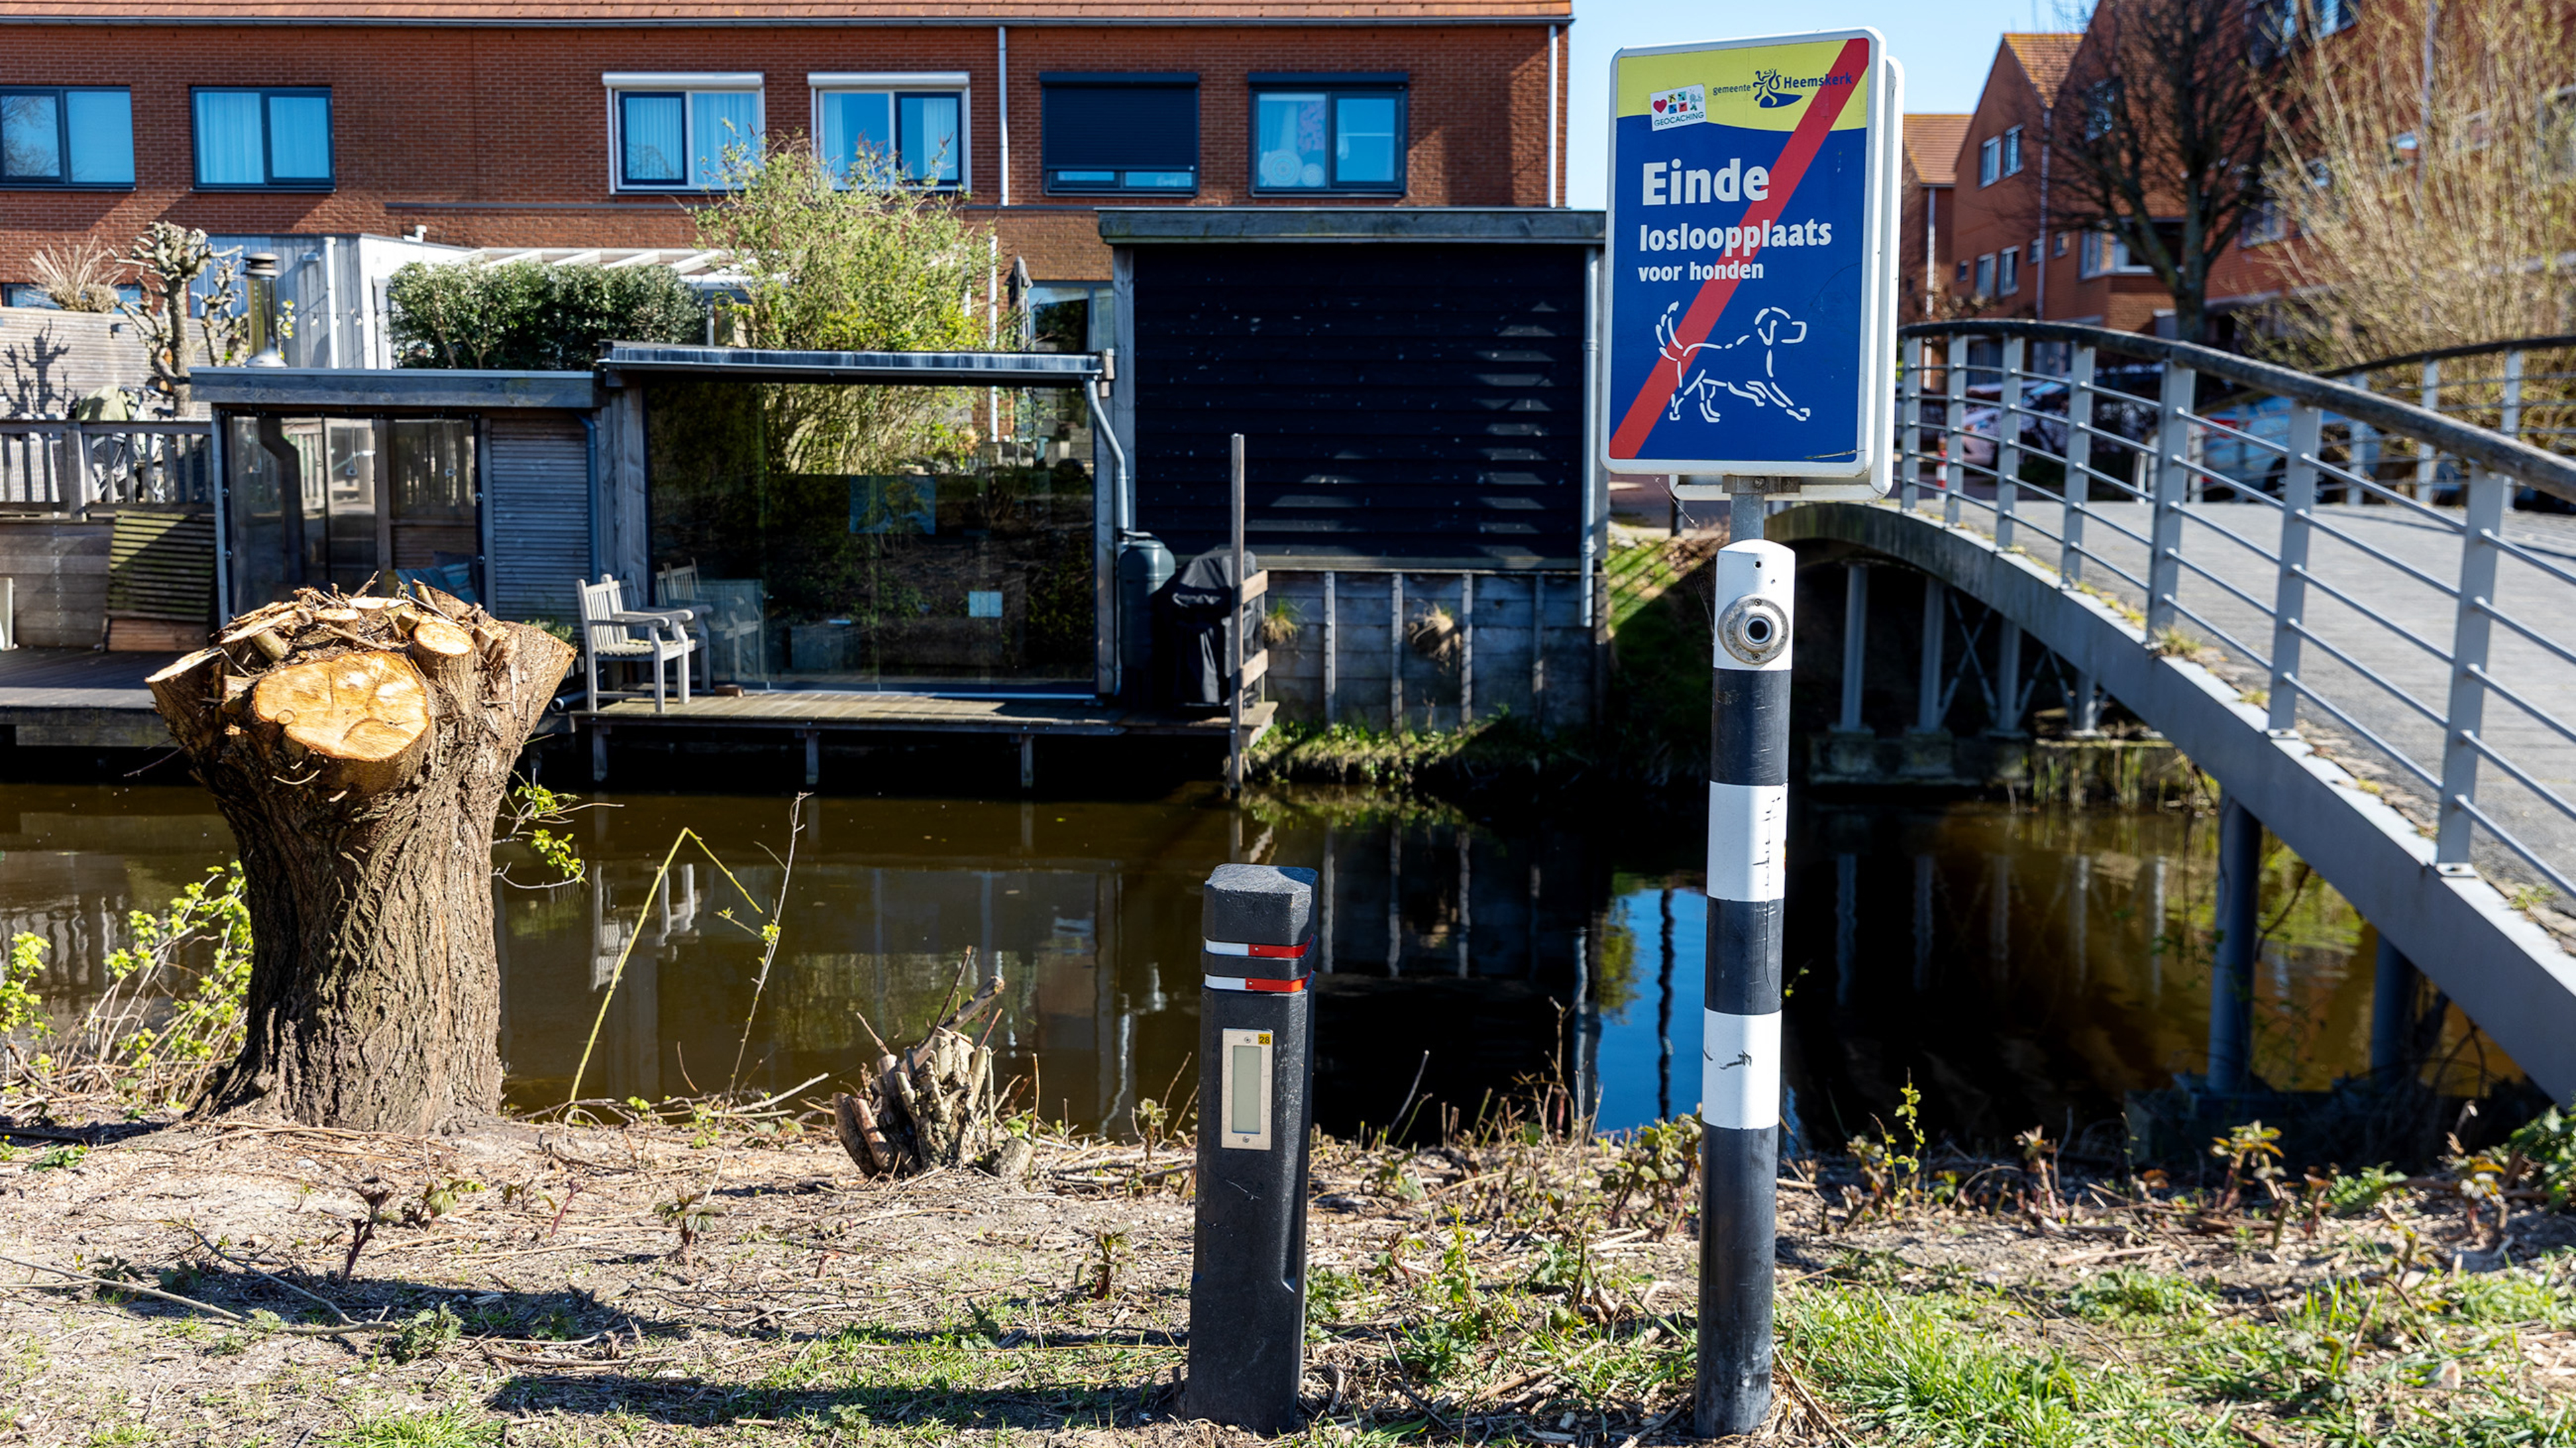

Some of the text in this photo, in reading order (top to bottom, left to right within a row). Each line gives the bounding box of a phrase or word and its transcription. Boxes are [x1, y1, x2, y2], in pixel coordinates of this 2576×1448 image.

[1713, 71, 1853, 96] gemeente Heemskerk
[1654, 111, 1705, 127] GEOCACHING
[1642, 158, 1770, 206] Einde
[1640, 219, 1832, 257] losloopplaats
[1638, 260, 1764, 282] voor honden
